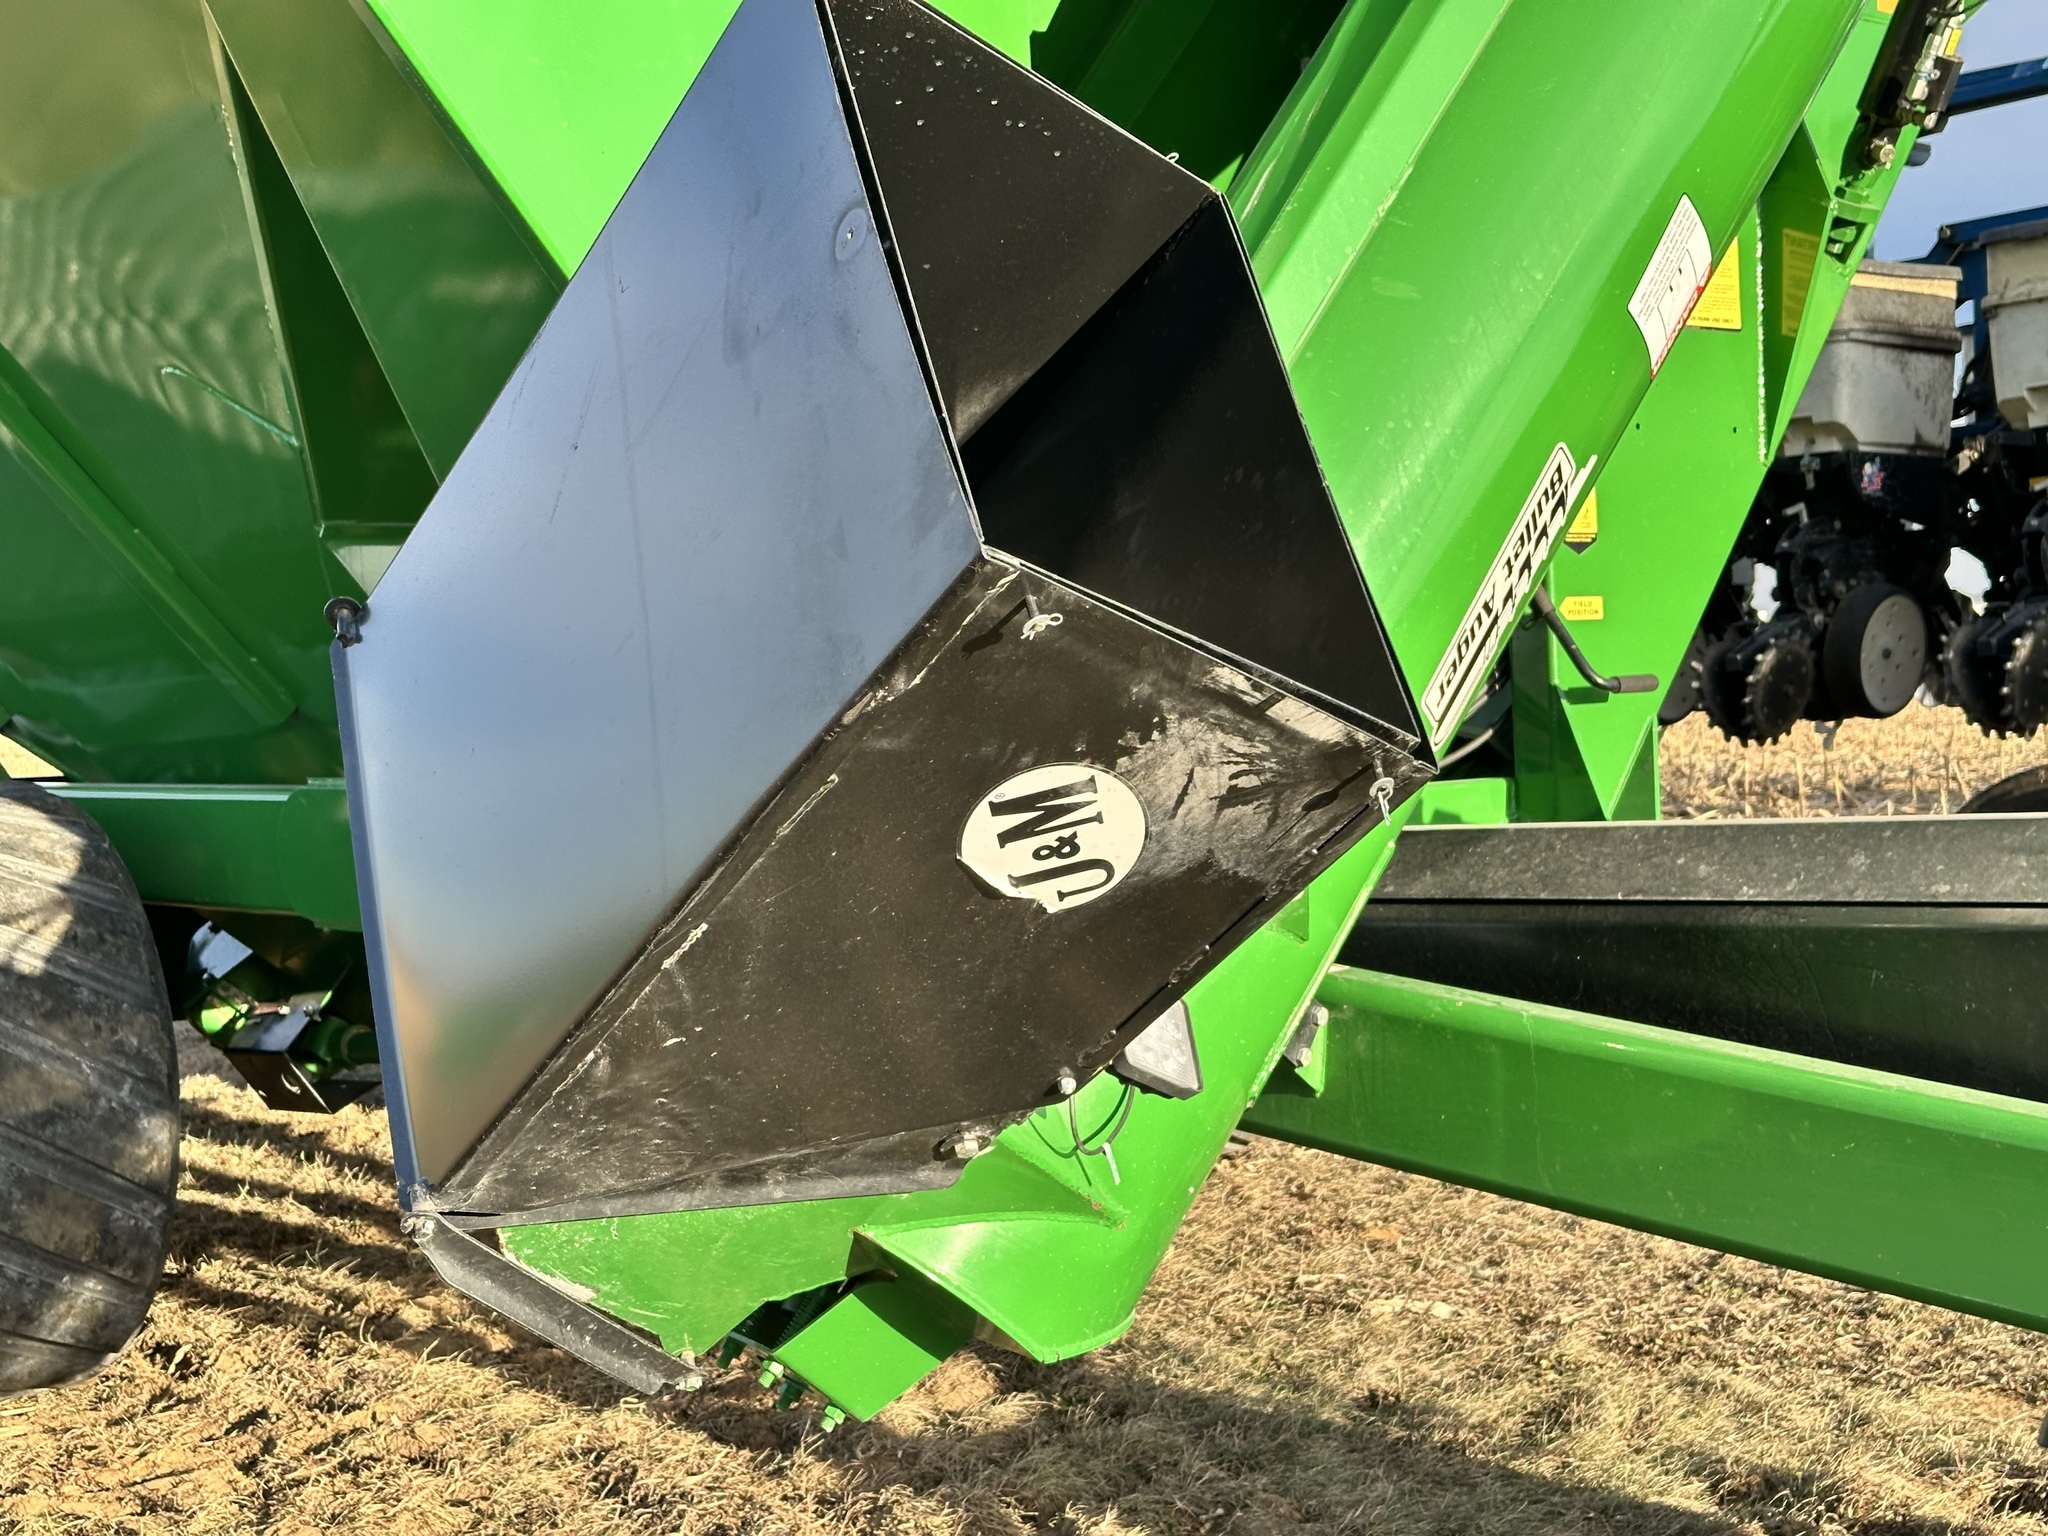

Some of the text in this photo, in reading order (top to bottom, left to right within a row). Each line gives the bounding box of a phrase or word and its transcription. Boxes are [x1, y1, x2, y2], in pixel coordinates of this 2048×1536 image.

[1436, 461, 1564, 707] Bullet Auger
[1567, 608, 1600, 616] POSITION
[1573, 600, 1593, 608] FIELD
[988, 775, 1115, 902] J&M
